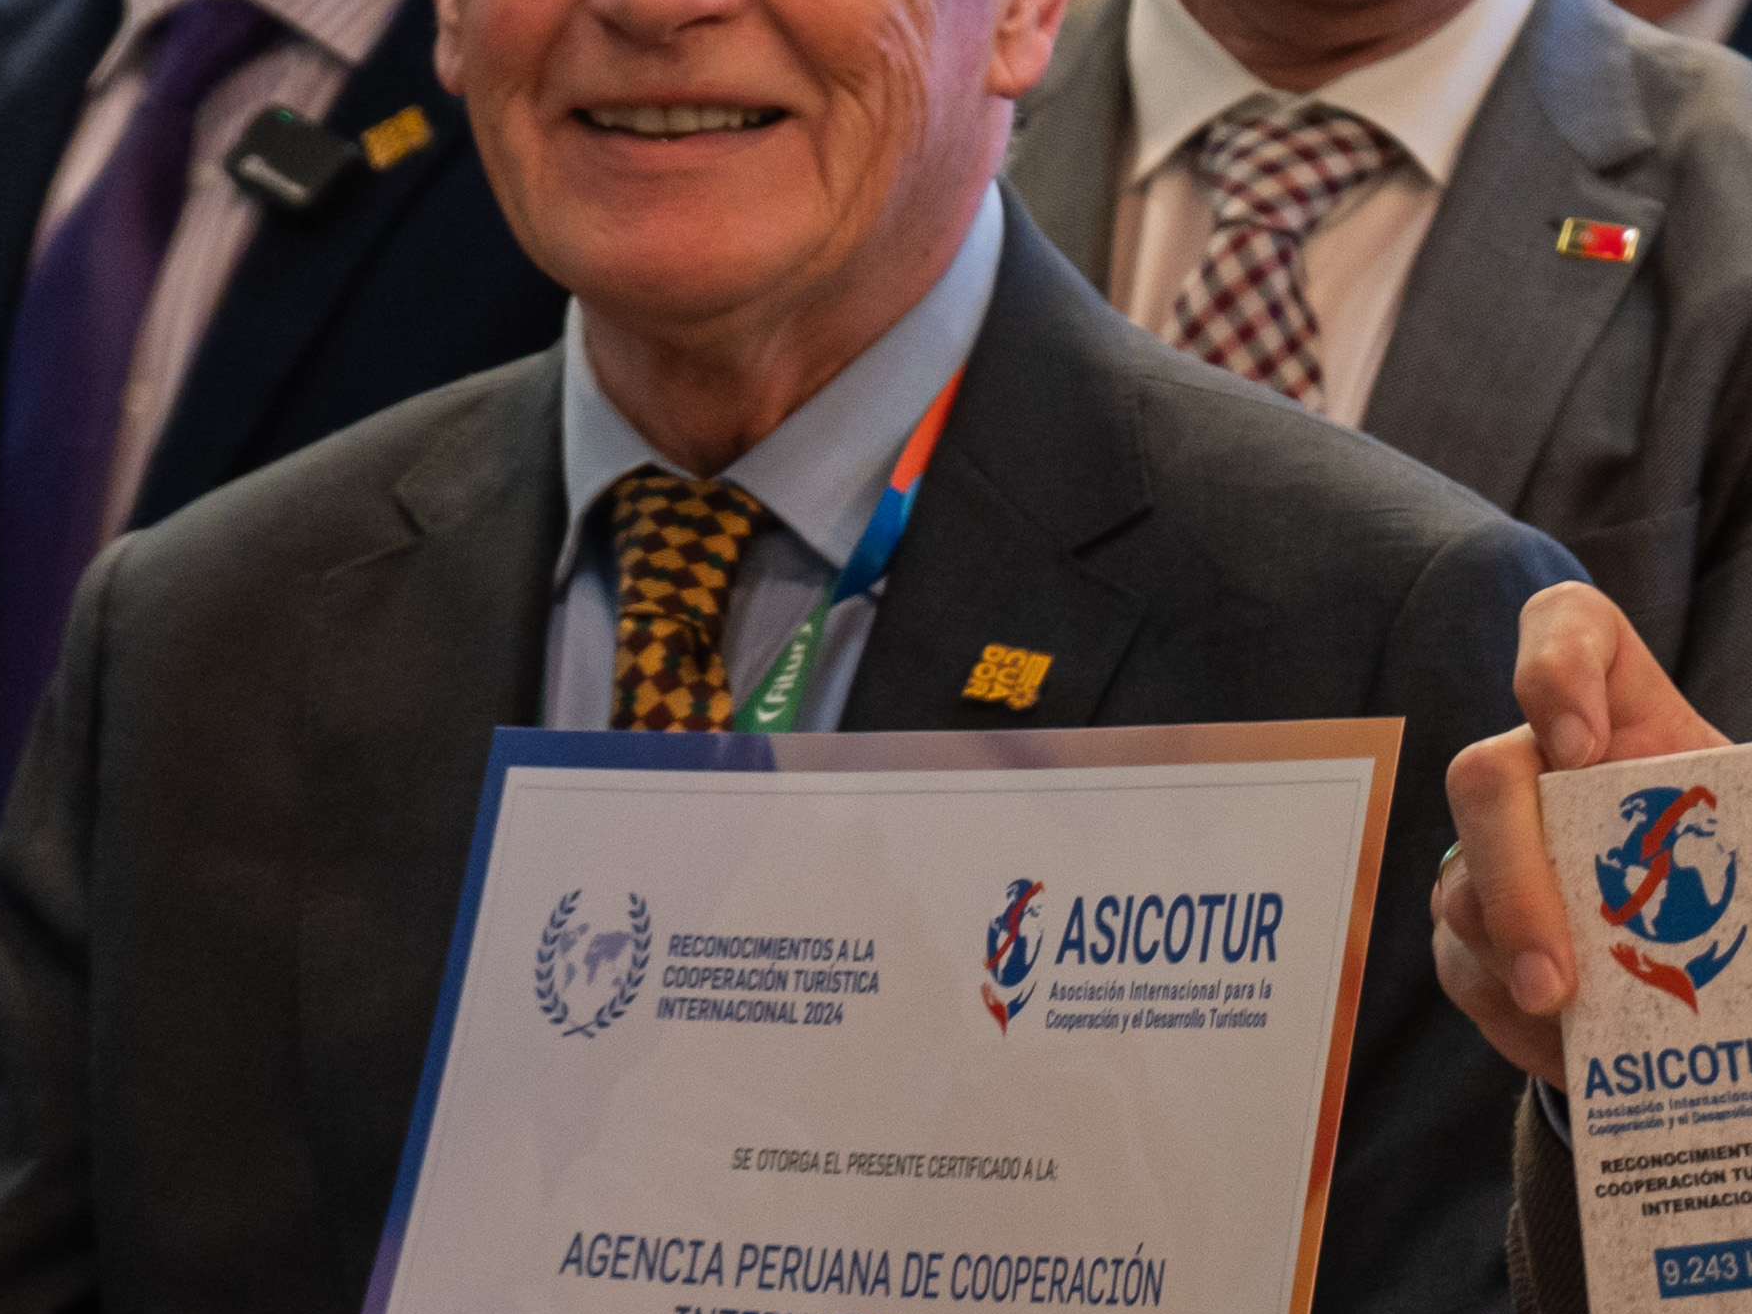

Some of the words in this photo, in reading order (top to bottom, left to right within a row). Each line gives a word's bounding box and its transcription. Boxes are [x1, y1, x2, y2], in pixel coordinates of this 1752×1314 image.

[1054, 892, 1283, 965] ASICOTUR
[668, 934, 833, 961] RECONOCIMIENTOS
[837, 939, 849, 961] A
[853, 939, 874, 962] LA
[662, 963, 787, 992] COOPERACIÓN
[795, 965, 879, 994] TURÍSTICA
[1049, 980, 1124, 1001] Asociación
[1130, 979, 1221, 1000] Internacional
[1224, 981, 1253, 1004] para
[1259, 978, 1271, 998] la
[657, 998, 797, 1024] INTERNACIONAL
[804, 1002, 844, 1025] 2024
[1045, 1008, 1119, 1033] Cooperación
[1121, 1012, 1130, 1034] y
[1132, 1008, 1143, 1029] el
[1145, 1008, 1205, 1029] Desarrollo
[1209, 1008, 1267, 1029] Turísticos
[1587, 1100, 1664, 1121] Asociación
[732, 1148, 754, 1170] SE
[757, 1149, 819, 1173] OTORGA
[824, 1151, 842, 1174] EL
[848, 1152, 925, 1177] PRESENTE
[928, 1155, 1022, 1180] CERTIFICADO
[1023, 1158, 1033, 1180] A
[1595, 1168, 1726, 1198] COOPERACIÓN
[558, 1231, 724, 1287] AGENCIA
[735, 1242, 890, 1298] PERUANA
[901, 1252, 944, 1300] DE
[949, 1243, 1166, 1307] COOPERACIÓN
[1662, 1252, 1738, 1286] 9.243
